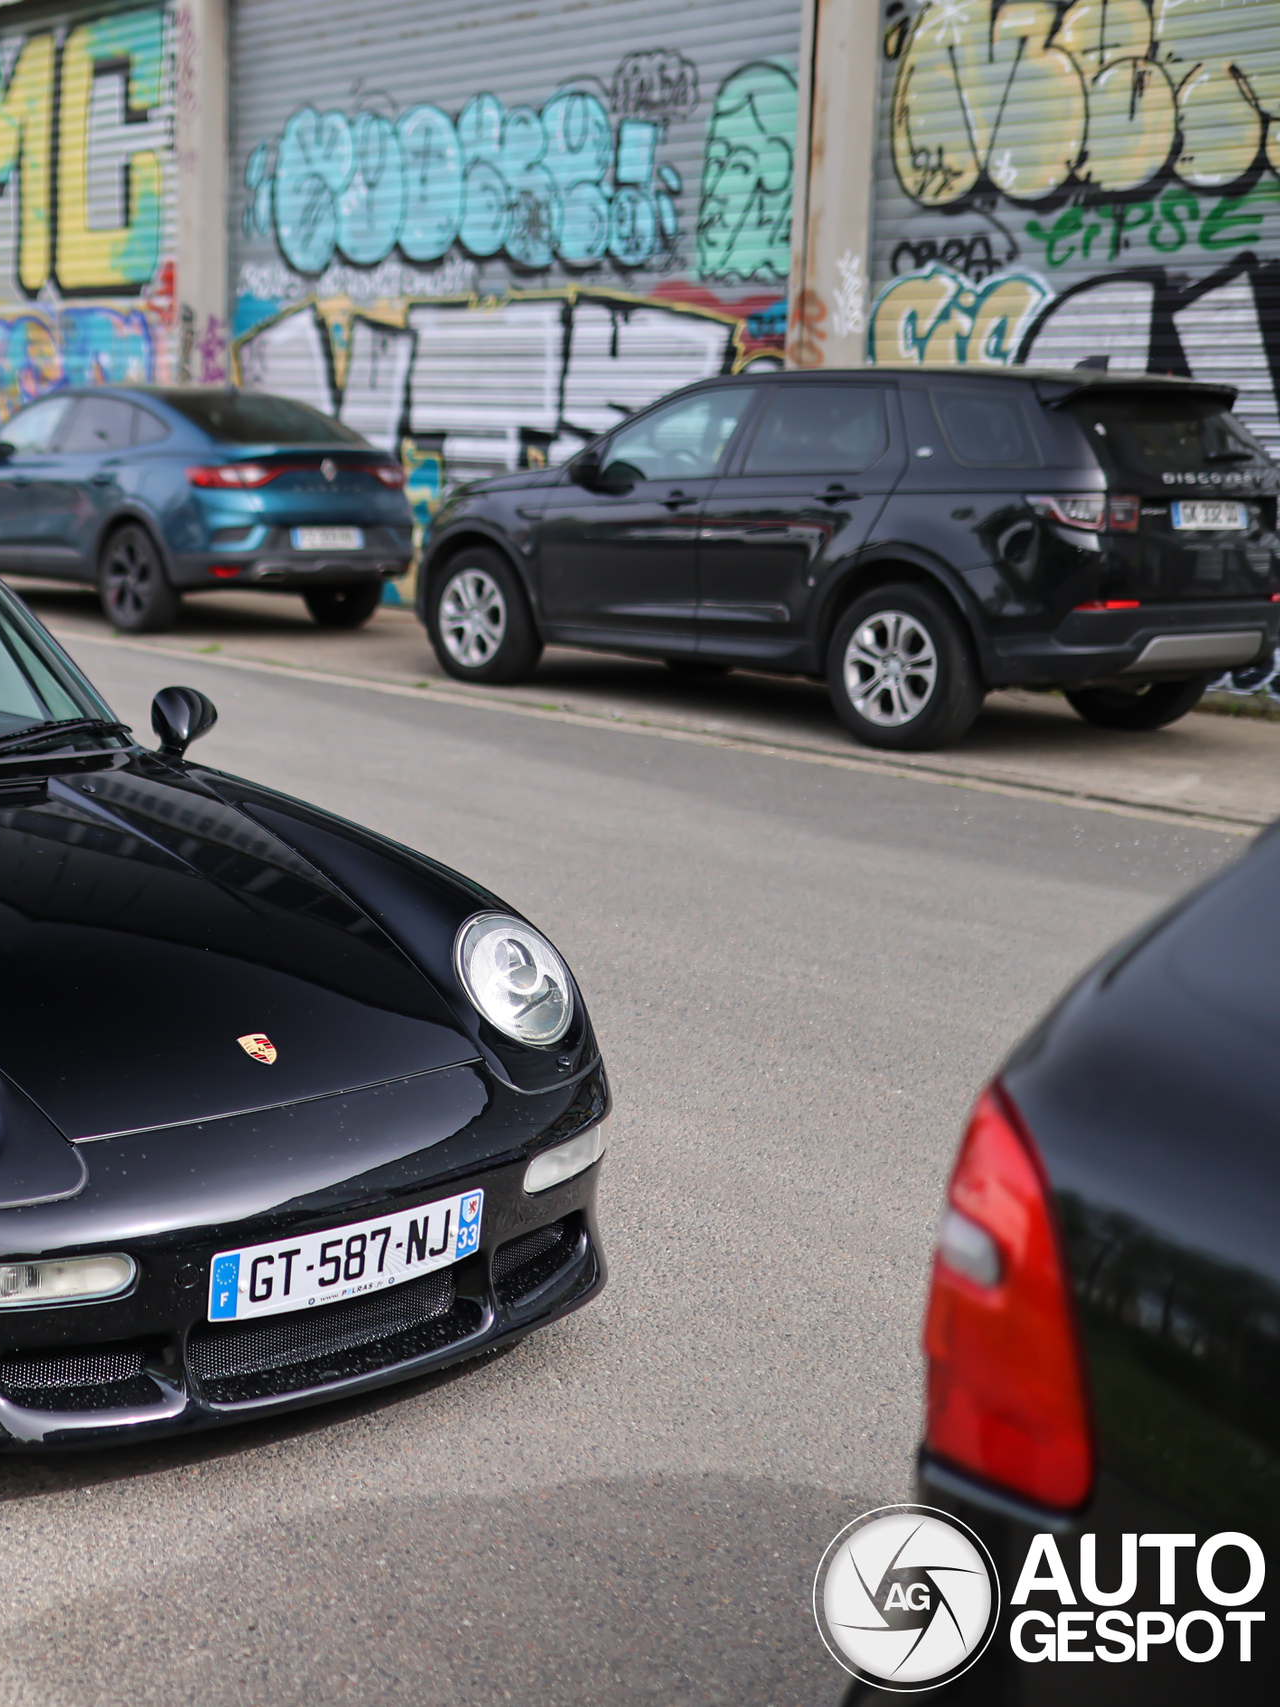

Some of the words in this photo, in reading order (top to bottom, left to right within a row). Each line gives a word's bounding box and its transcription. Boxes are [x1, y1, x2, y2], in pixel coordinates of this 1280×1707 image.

[457, 1223, 478, 1250] 33
[249, 1208, 452, 1304] GT-587-NJ
[220, 1291, 230, 1308] F
